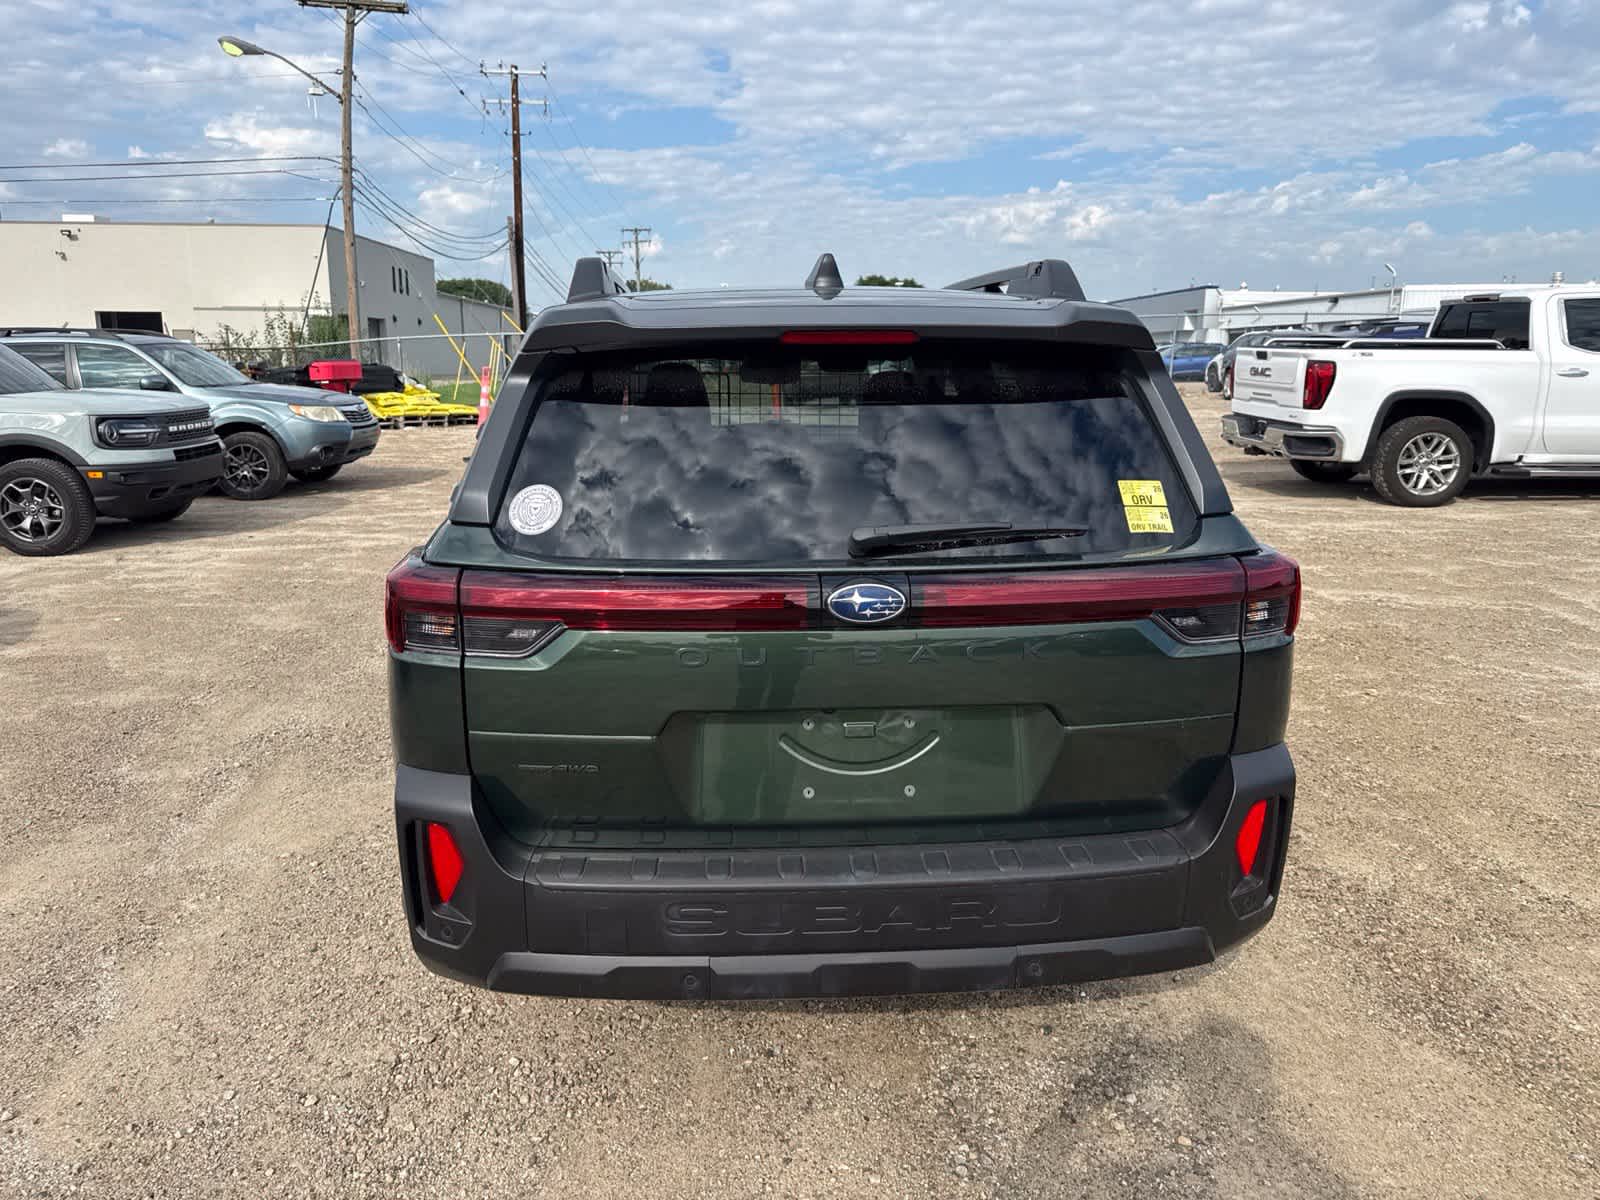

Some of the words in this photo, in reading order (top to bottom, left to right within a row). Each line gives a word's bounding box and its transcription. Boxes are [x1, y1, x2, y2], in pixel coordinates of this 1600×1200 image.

[1249, 366, 1272, 378] GMC
[168, 421, 213, 432] BRONCO
[1131, 494, 1153, 505] ORV
[1131, 523, 1146, 531] ORV
[1148, 523, 1169, 531] TRAIL
[673, 642, 1051, 668] OUTBACK
[663, 898, 1064, 937] SUBARU
